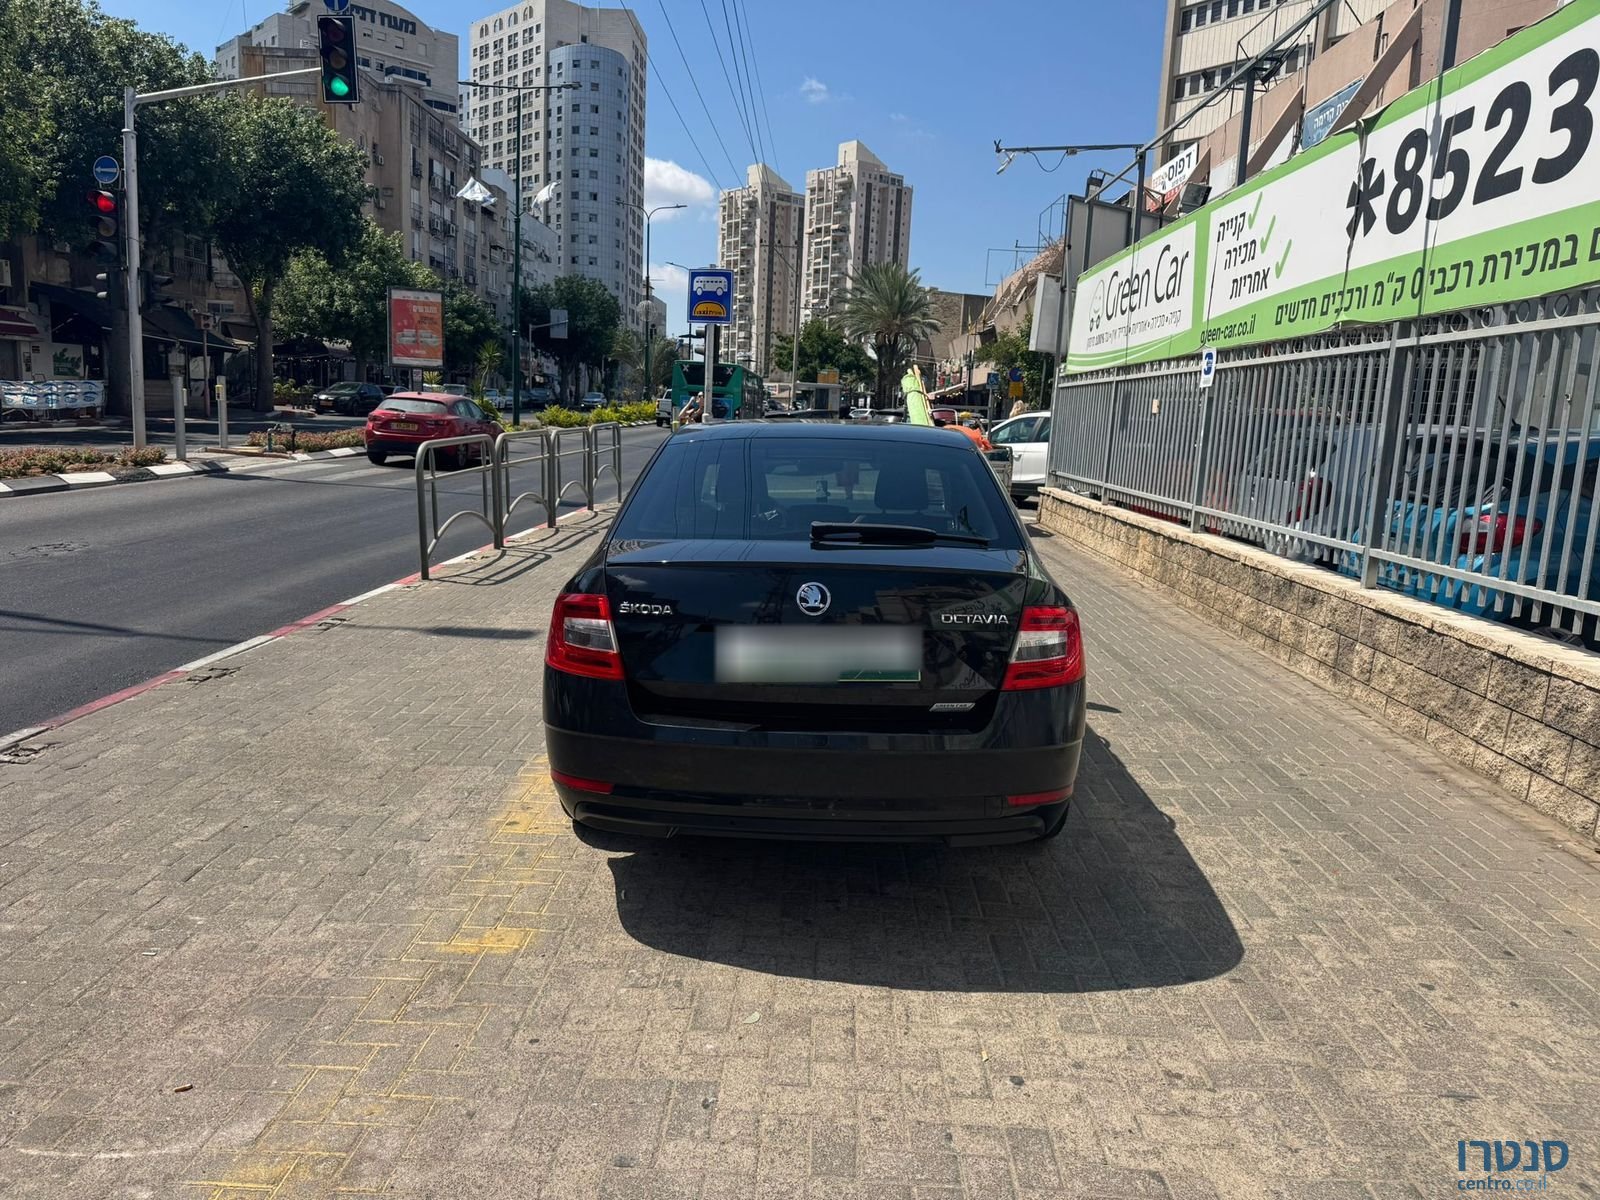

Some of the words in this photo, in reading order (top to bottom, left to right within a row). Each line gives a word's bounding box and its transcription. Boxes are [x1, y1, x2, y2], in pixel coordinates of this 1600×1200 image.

[1168, 152, 1192, 181] דפוס
[1217, 212, 1246, 242] קנייה
[1224, 239, 1256, 270] מכירה
[1480, 233, 1578, 285] במכירת
[1106, 268, 1151, 321] Green
[1155, 244, 1189, 303] Car
[1229, 267, 1271, 300] אחריות
[1430, 259, 1474, 296] רכבי
[1275, 297, 1317, 325] חדשים
[1320, 284, 1368, 316] ורכבים
[619, 601, 673, 615] ŠKODA
[941, 613, 1009, 624] OCTAVIA
